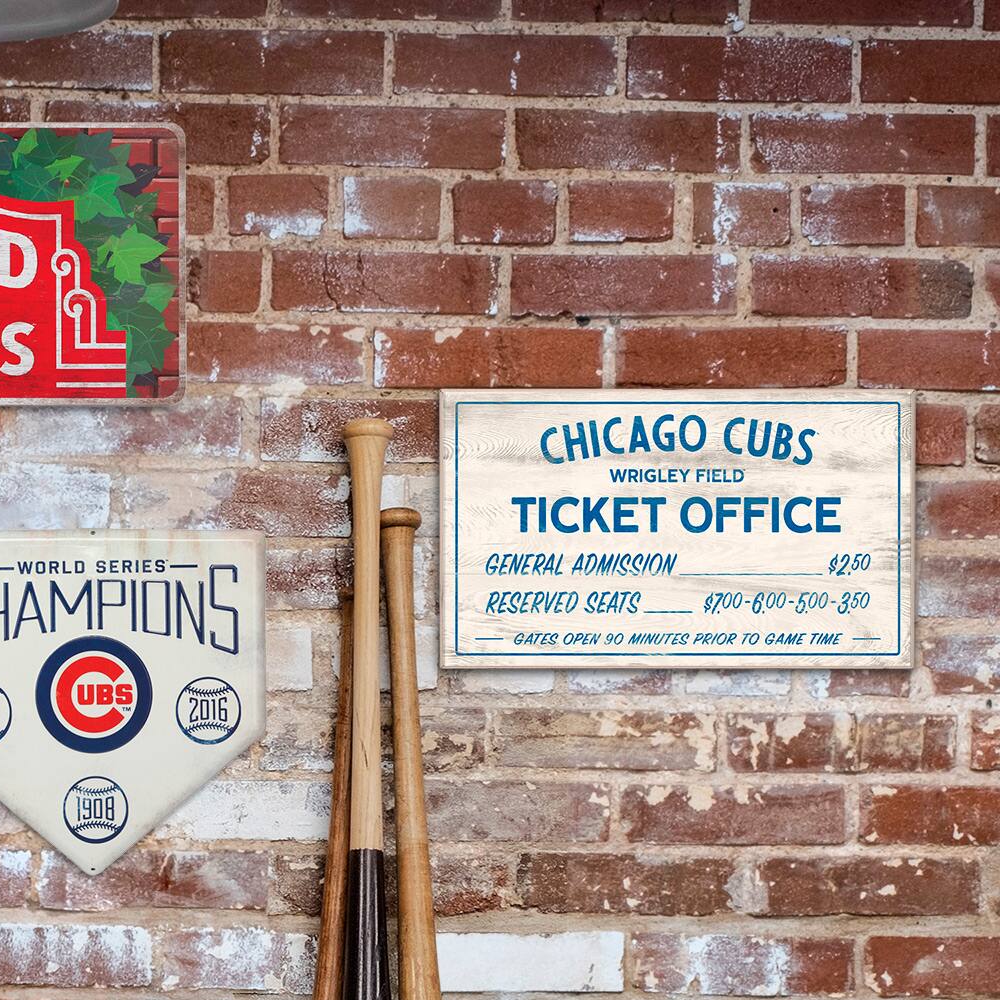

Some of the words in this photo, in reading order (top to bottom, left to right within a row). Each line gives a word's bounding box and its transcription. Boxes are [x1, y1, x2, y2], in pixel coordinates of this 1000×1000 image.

[540, 414, 707, 464] CHICAGO
[723, 417, 817, 465] CUBS
[610, 468, 690, 483] WRIGLEY
[696, 468, 745, 483] FIELD
[511, 496, 667, 534] TICKET
[679, 496, 842, 534] OFFICE
[17, 560, 86, 575] WORLD
[96, 559, 166, 574] SERIES
[485, 553, 564, 576] GENERAL
[571, 552, 677, 576] ADMISSION
[485, 591, 579, 614] RESERVED
[584, 591, 642, 614] SEATS
[513, 633, 560, 646] GATES
[563, 633, 599, 646] OPEN
[603, 633, 623, 646] 90
[628, 633, 690, 646] MINUTES
[693, 633, 739, 646] PRIOR
[742, 633, 760, 646] TO
[764, 633, 807, 646] GAME
[810, 633, 843, 646] TIME
[56, 655, 134, 734] CUBS
[189, 697, 228, 722] 2016
[75, 796, 115, 822] 1908
